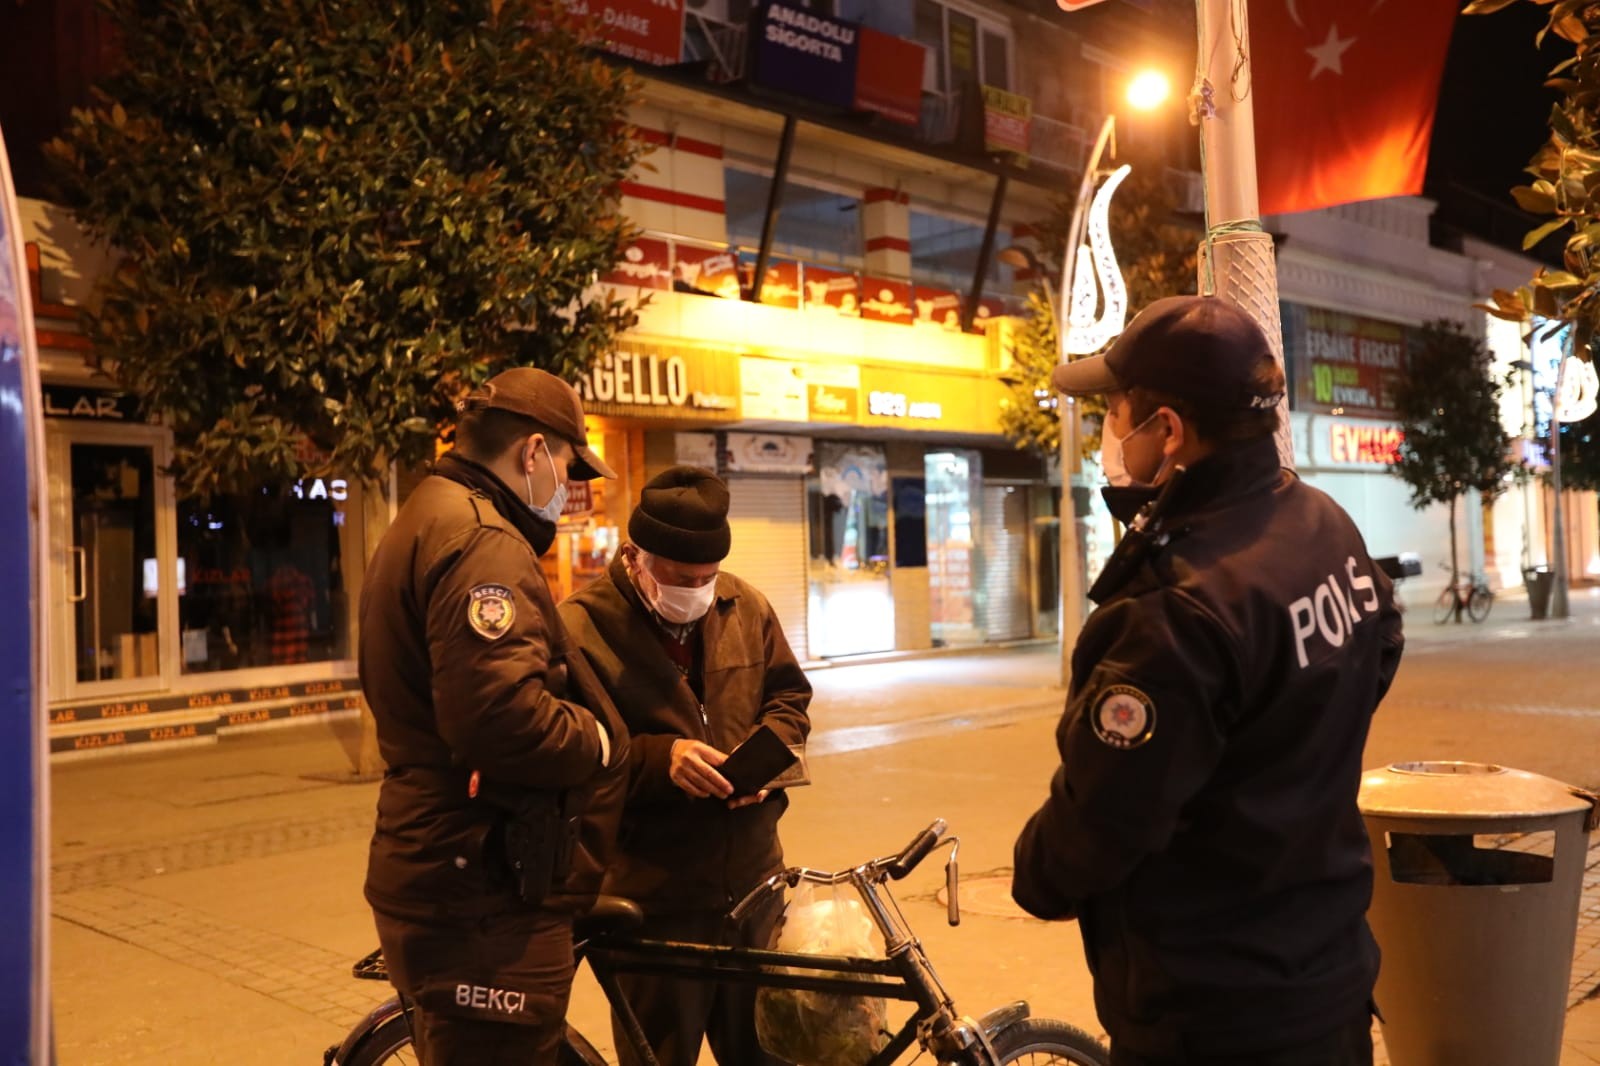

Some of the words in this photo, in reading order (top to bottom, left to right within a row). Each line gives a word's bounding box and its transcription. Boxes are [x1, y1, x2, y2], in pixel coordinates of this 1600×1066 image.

[603, 7, 650, 36] DAİRE
[768, 4, 855, 45] ANADOLU
[765, 24, 842, 63] SİGORTA
[101, 702, 150, 718] KIZLAR
[188, 693, 232, 708] KIZLAR
[250, 687, 290, 701] KIZLAR
[305, 680, 343, 695] KIZLAR
[75, 731, 126, 749] KIZLAR
[150, 724, 197, 741] KIZLAR
[229, 709, 270, 725] KIZLAR
[290, 700, 329, 716] KIZLAR
